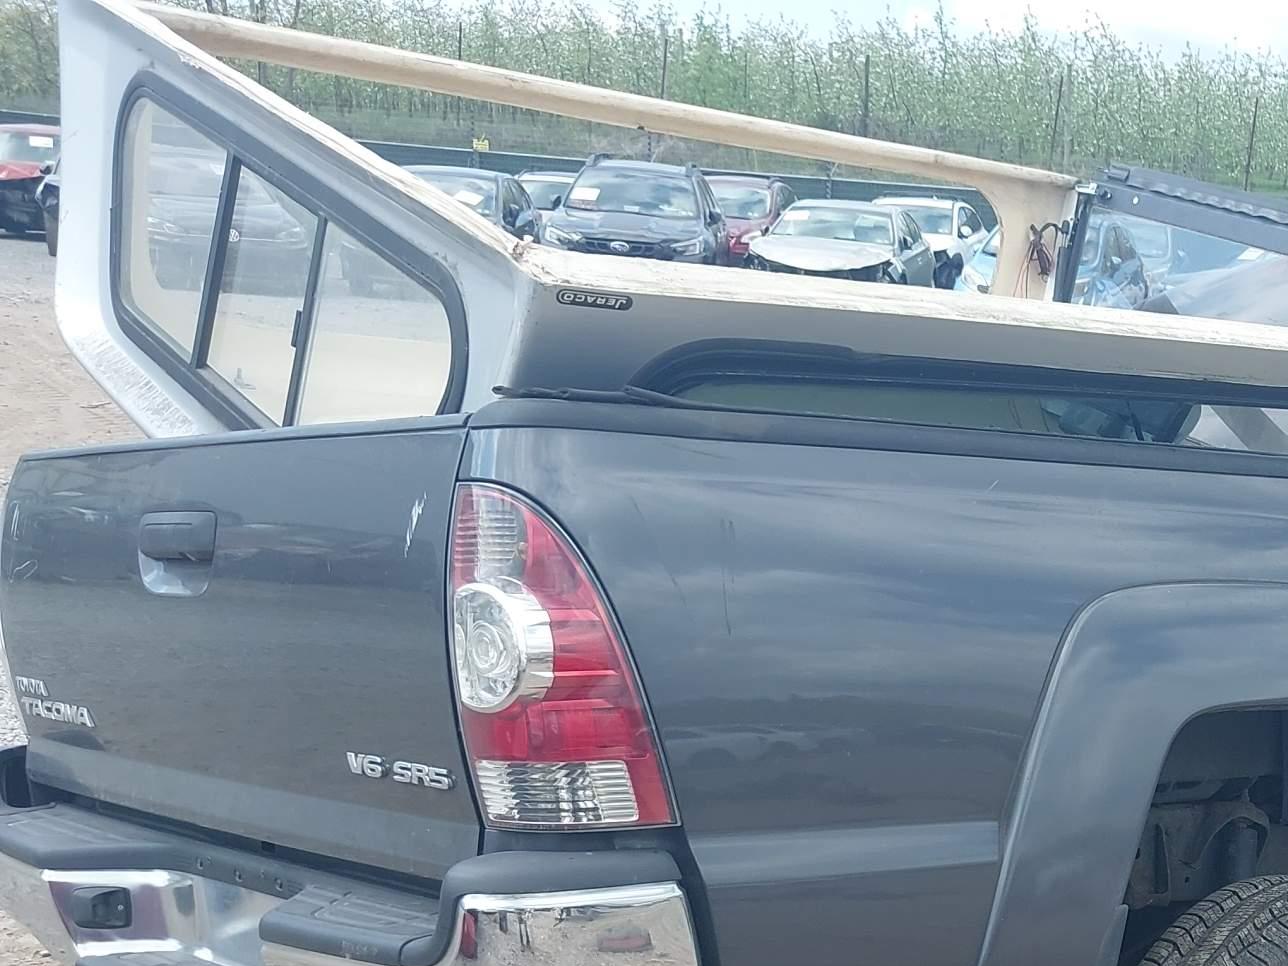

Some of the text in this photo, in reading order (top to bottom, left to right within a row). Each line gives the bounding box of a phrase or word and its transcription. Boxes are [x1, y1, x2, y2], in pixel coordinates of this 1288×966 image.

[562, 292, 627, 309] JERACO
[21, 695, 96, 728] TACOMA
[345, 751, 452, 790] V6 SR5
